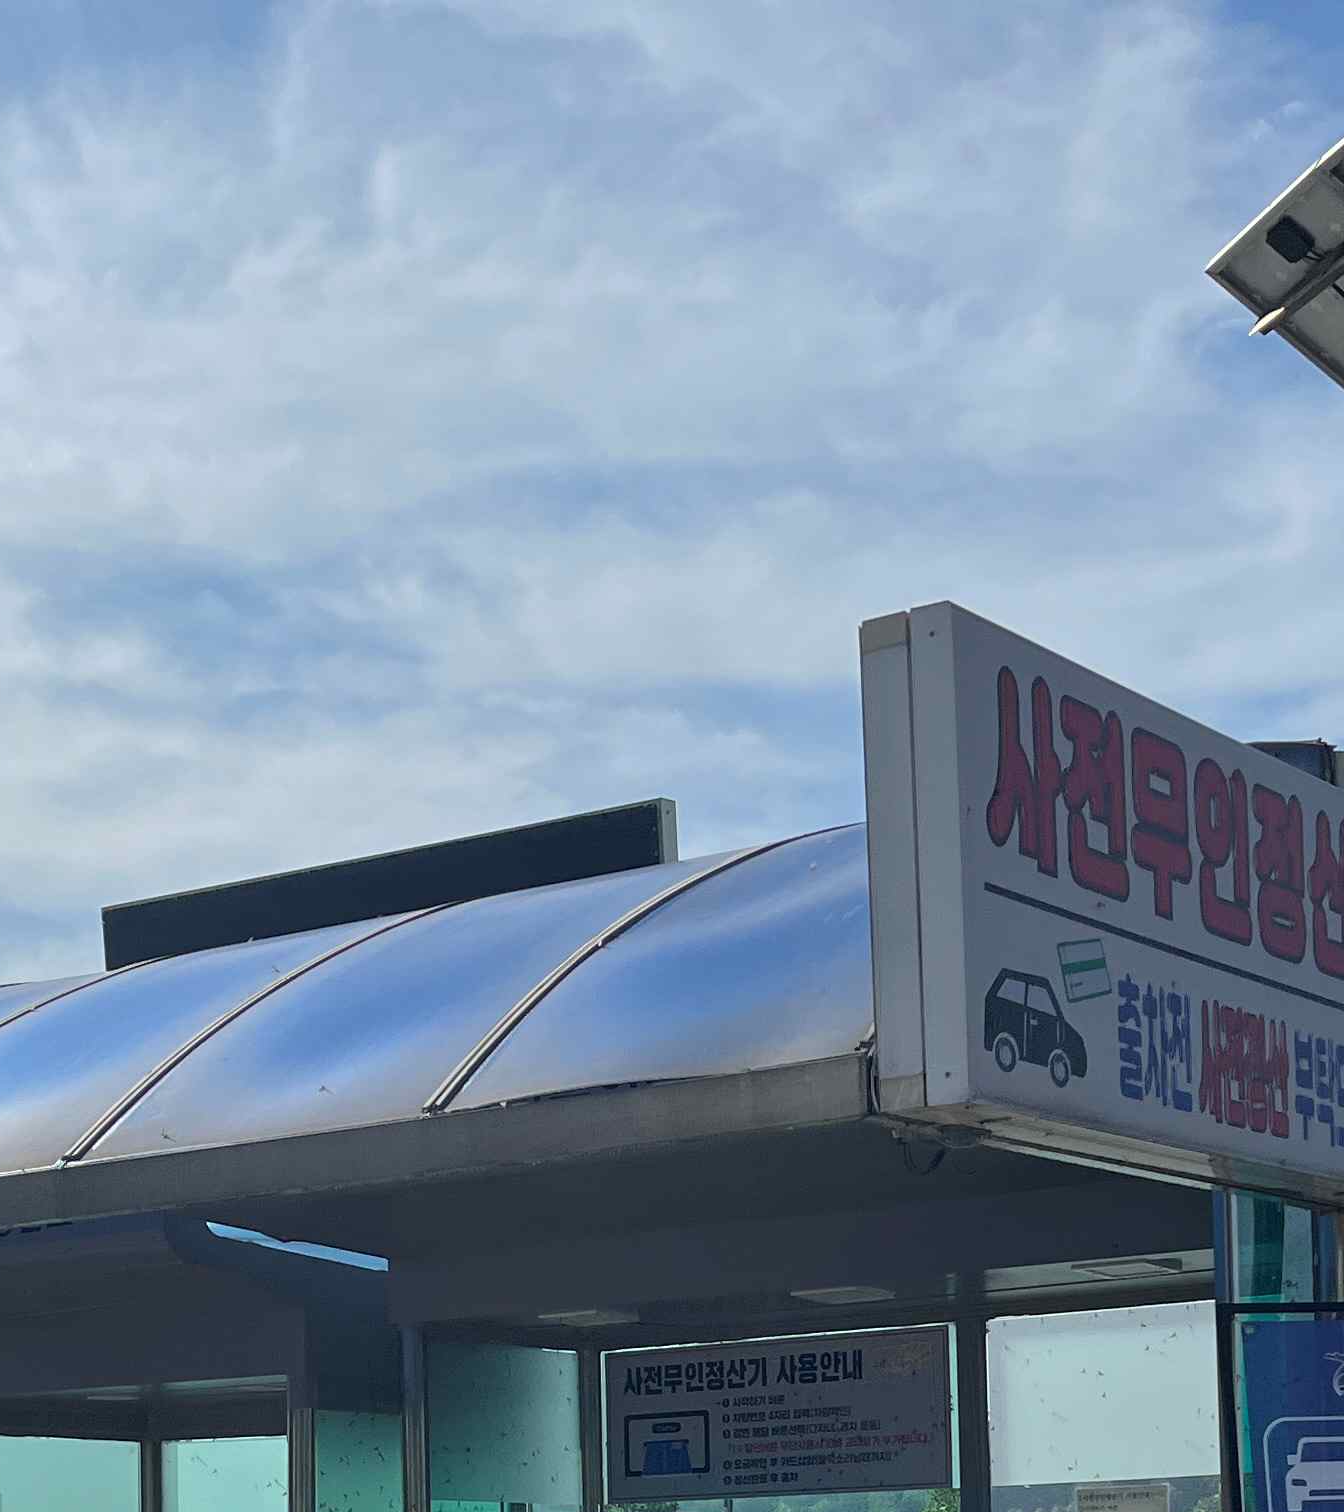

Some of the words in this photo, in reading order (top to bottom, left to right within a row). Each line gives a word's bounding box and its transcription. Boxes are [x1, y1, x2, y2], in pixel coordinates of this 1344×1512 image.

[1118, 972, 1193, 1112] 출차전
[1199, 1000, 1289, 1138] 사전정산
[623, 1357, 767, 1396] 사전무인정산기
[776, 1350, 864, 1386] 사용안내
